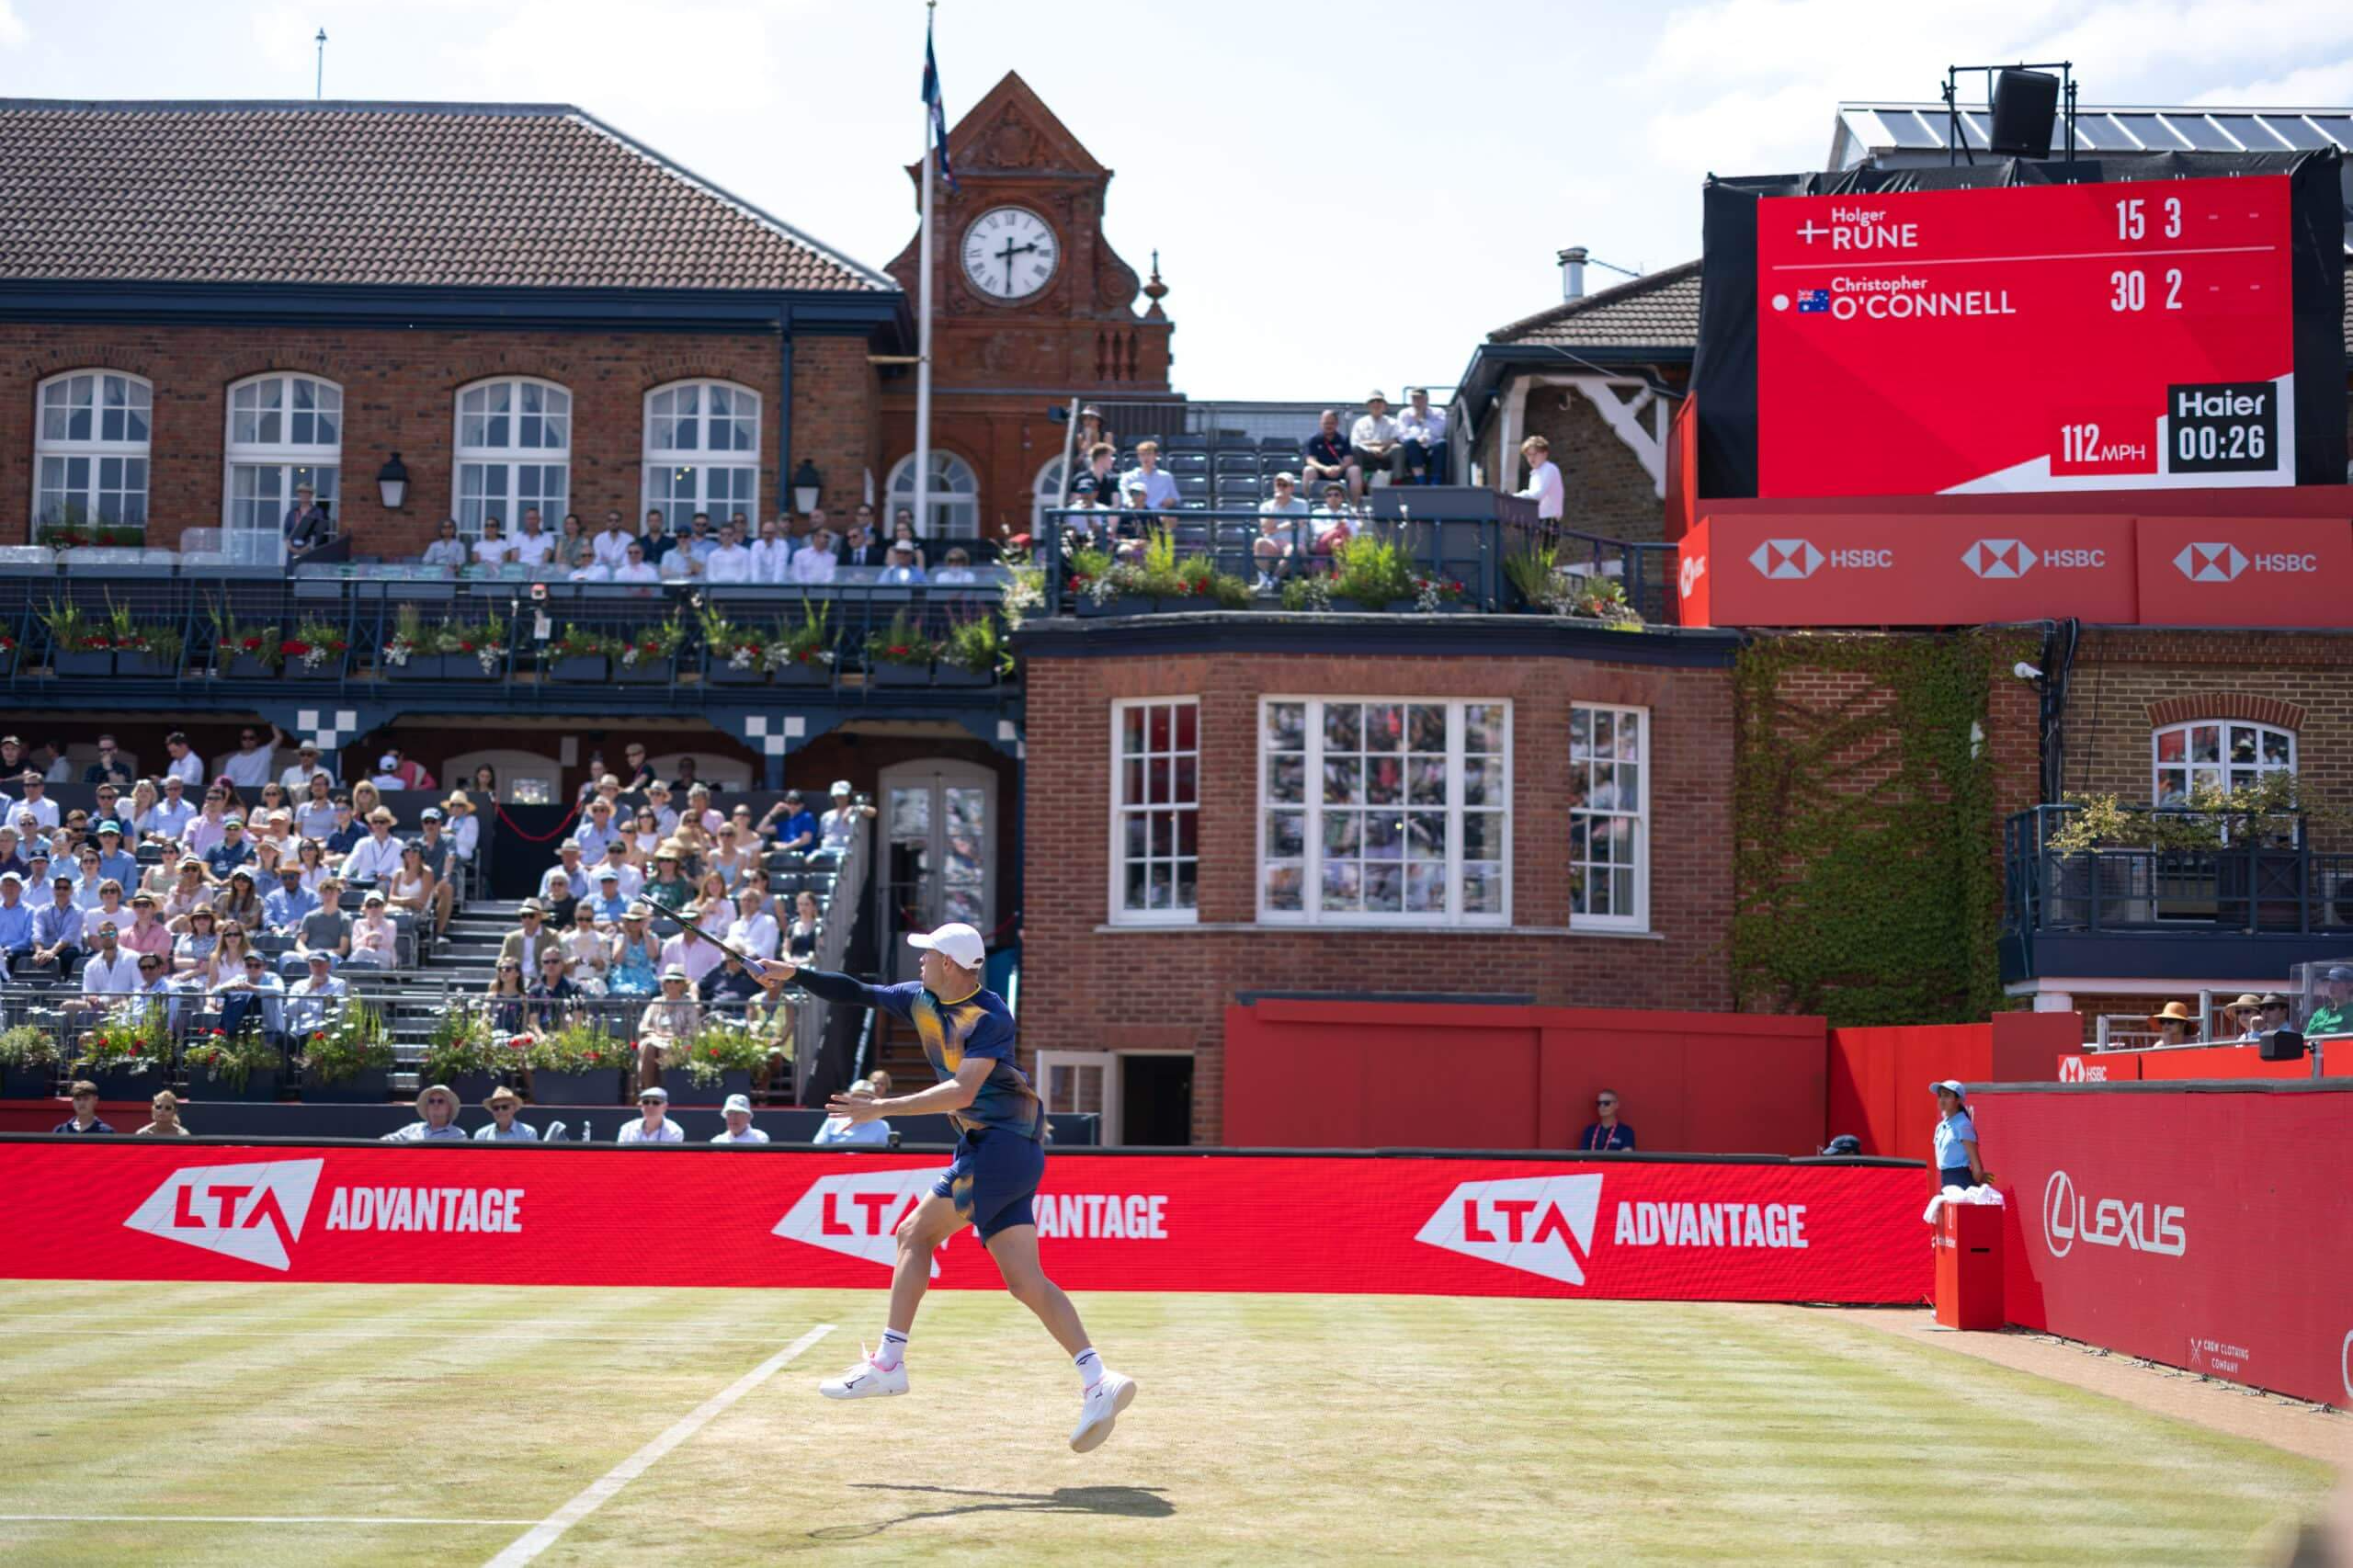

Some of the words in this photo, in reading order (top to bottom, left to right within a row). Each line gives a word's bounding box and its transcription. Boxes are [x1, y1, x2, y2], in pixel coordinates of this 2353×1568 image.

[1832, 208, 1886, 227] Holger
[2116, 199, 2145, 240] 15
[2165, 197, 2181, 238] 3
[1832, 223, 1918, 250] RUNE
[1832, 275, 1928, 296] Christopher
[2110, 270, 2145, 312] 30
[2165, 268, 2183, 309] 2
[1832, 290, 2017, 320] O'CONNELL
[2178, 390, 2266, 417] Haier
[2062, 424, 2099, 462] 112
[2101, 444, 2146, 461] MPH
[2178, 425, 2266, 460] 00:26
[1831, 550, 1893, 568] HSBC
[2043, 550, 2106, 567] HSBC
[2255, 554, 2317, 572] HSBC
[2086, 1066, 2107, 1083] HSBC
[326, 1187, 525, 1233] ADVANTAGE
[972, 1194, 1168, 1239] ANTAGE
[1614, 1200, 1809, 1248] ADVANTAGE
[2079, 1196, 2187, 1257] LEXUS
